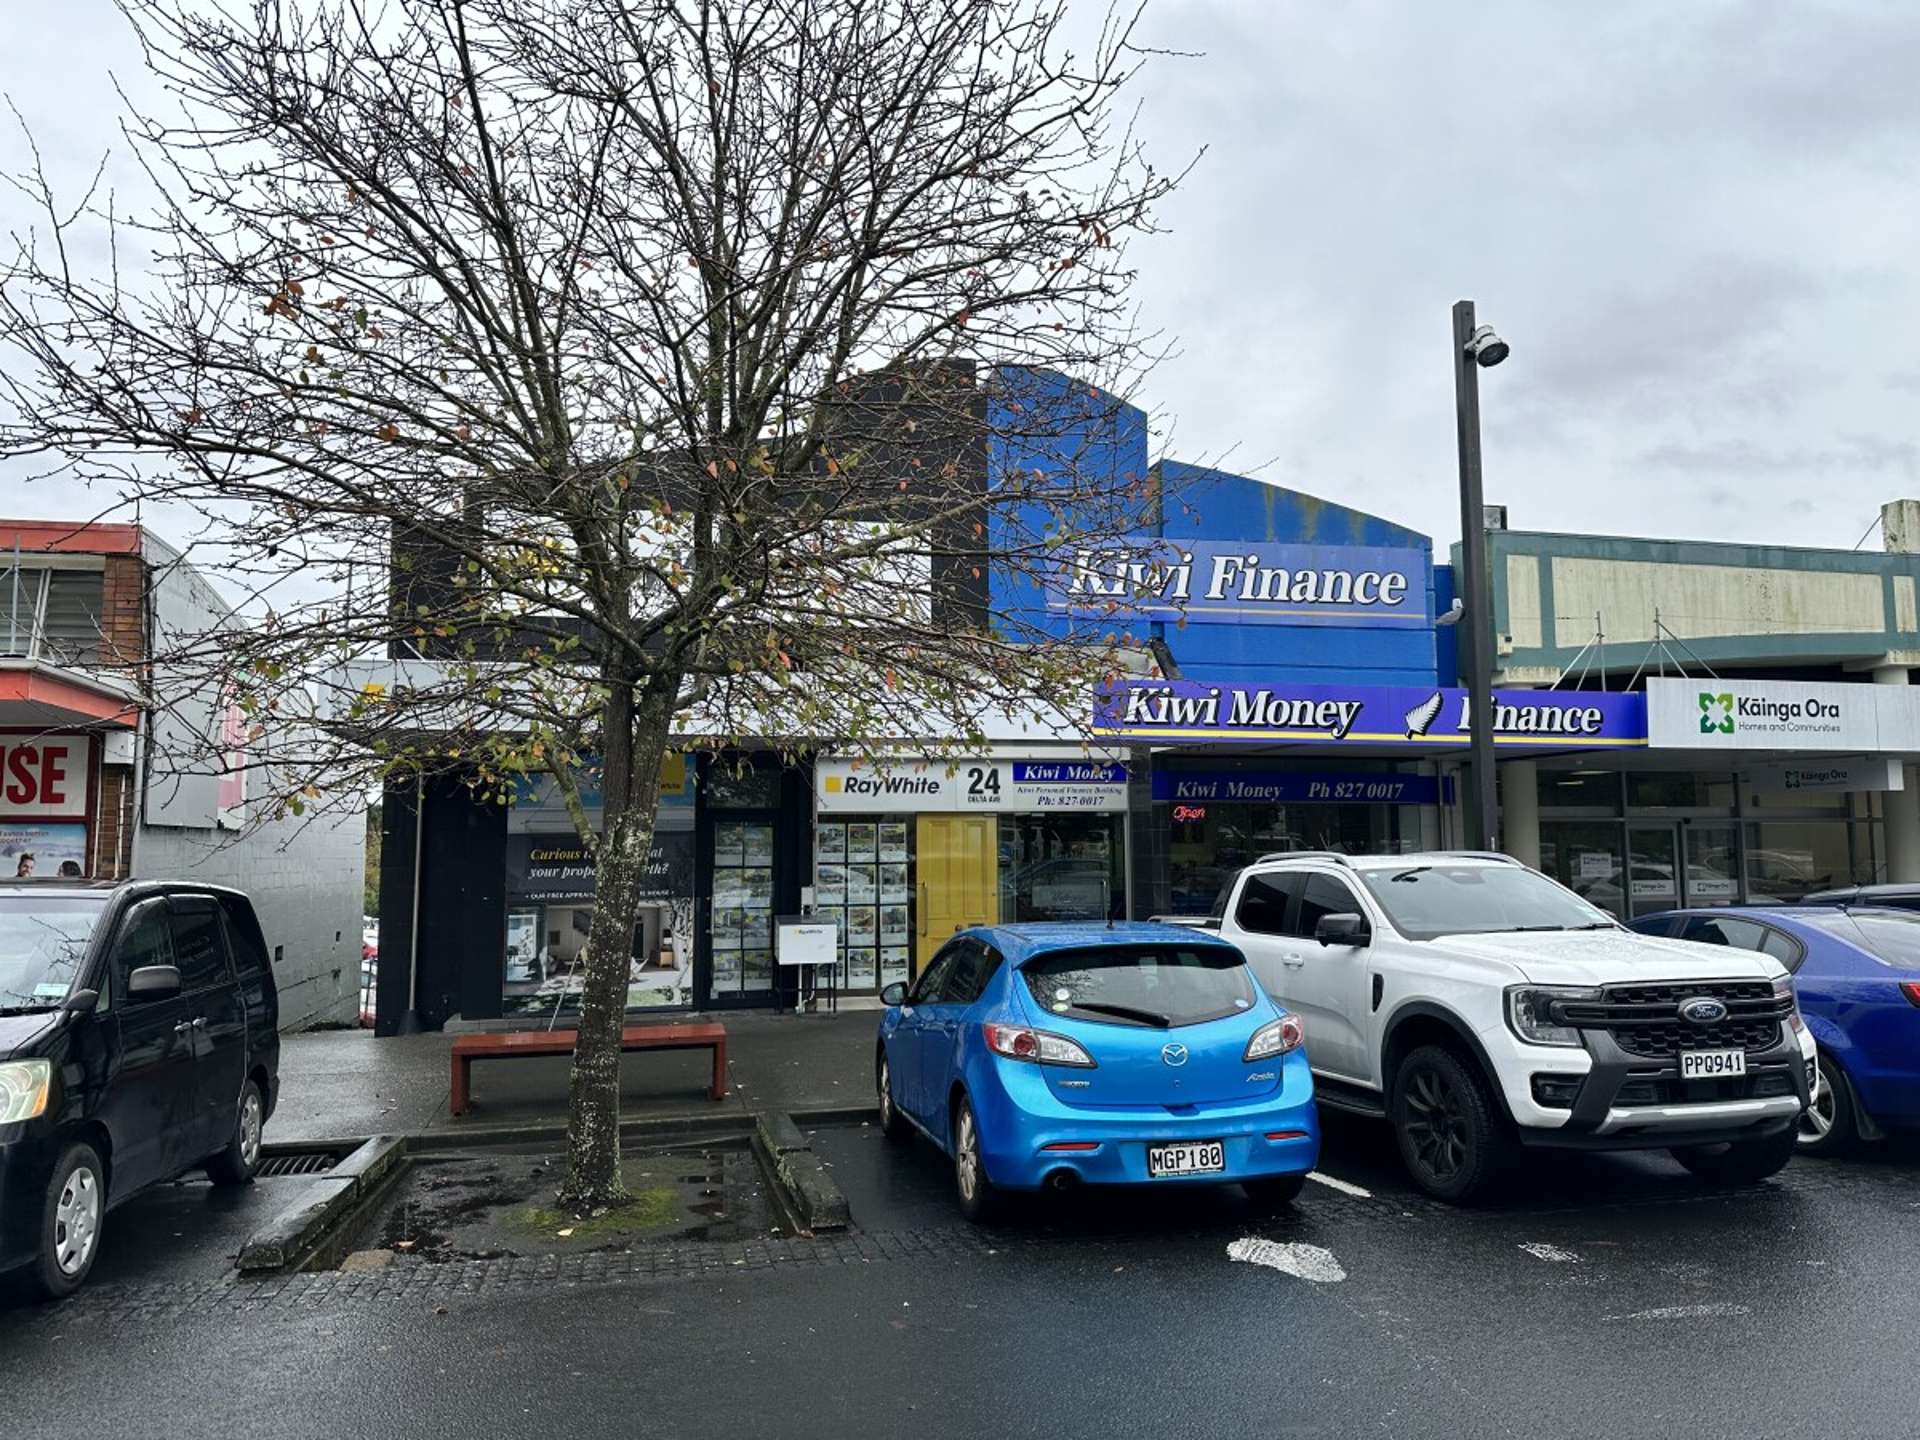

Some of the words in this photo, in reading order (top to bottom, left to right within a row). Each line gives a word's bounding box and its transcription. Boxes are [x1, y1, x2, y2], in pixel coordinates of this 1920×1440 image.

[1067, 548, 1193, 600] Kiwi
[1204, 554, 1408, 605] Finance
[1123, 686, 1221, 726] Kiwi
[1227, 690, 1361, 738] Money
[1738, 697, 1800, 721] Kāinga
[1805, 699, 1840, 718] Ora
[1739, 721, 1767, 731] Homes
[1769, 722, 1786, 732] and
[1787, 723, 1841, 733] Communities
[0, 745, 68, 805] SE
[967, 768, 1001, 794] 24
[1023, 766, 1060, 780] Kiwi
[844, 776, 940, 797] RayWhite
[1176, 782, 1217, 798] Kiwi
[1226, 782, 1283, 800] Money
[1308, 782, 1330, 798] Ph
[1335, 783, 1368, 798] 827
[1367, 783, 1404, 798] 0017
[1038, 796, 1056, 806] Ph:
[1173, 806, 1206, 822] Open
[530, 849, 581, 861] Curious
[528, 867, 560, 880] your
[1695, 1005, 1717, 1017] Ford
[1684, 1054, 1742, 1075] PPQ941
[1151, 1147, 1221, 1170] MGP180
